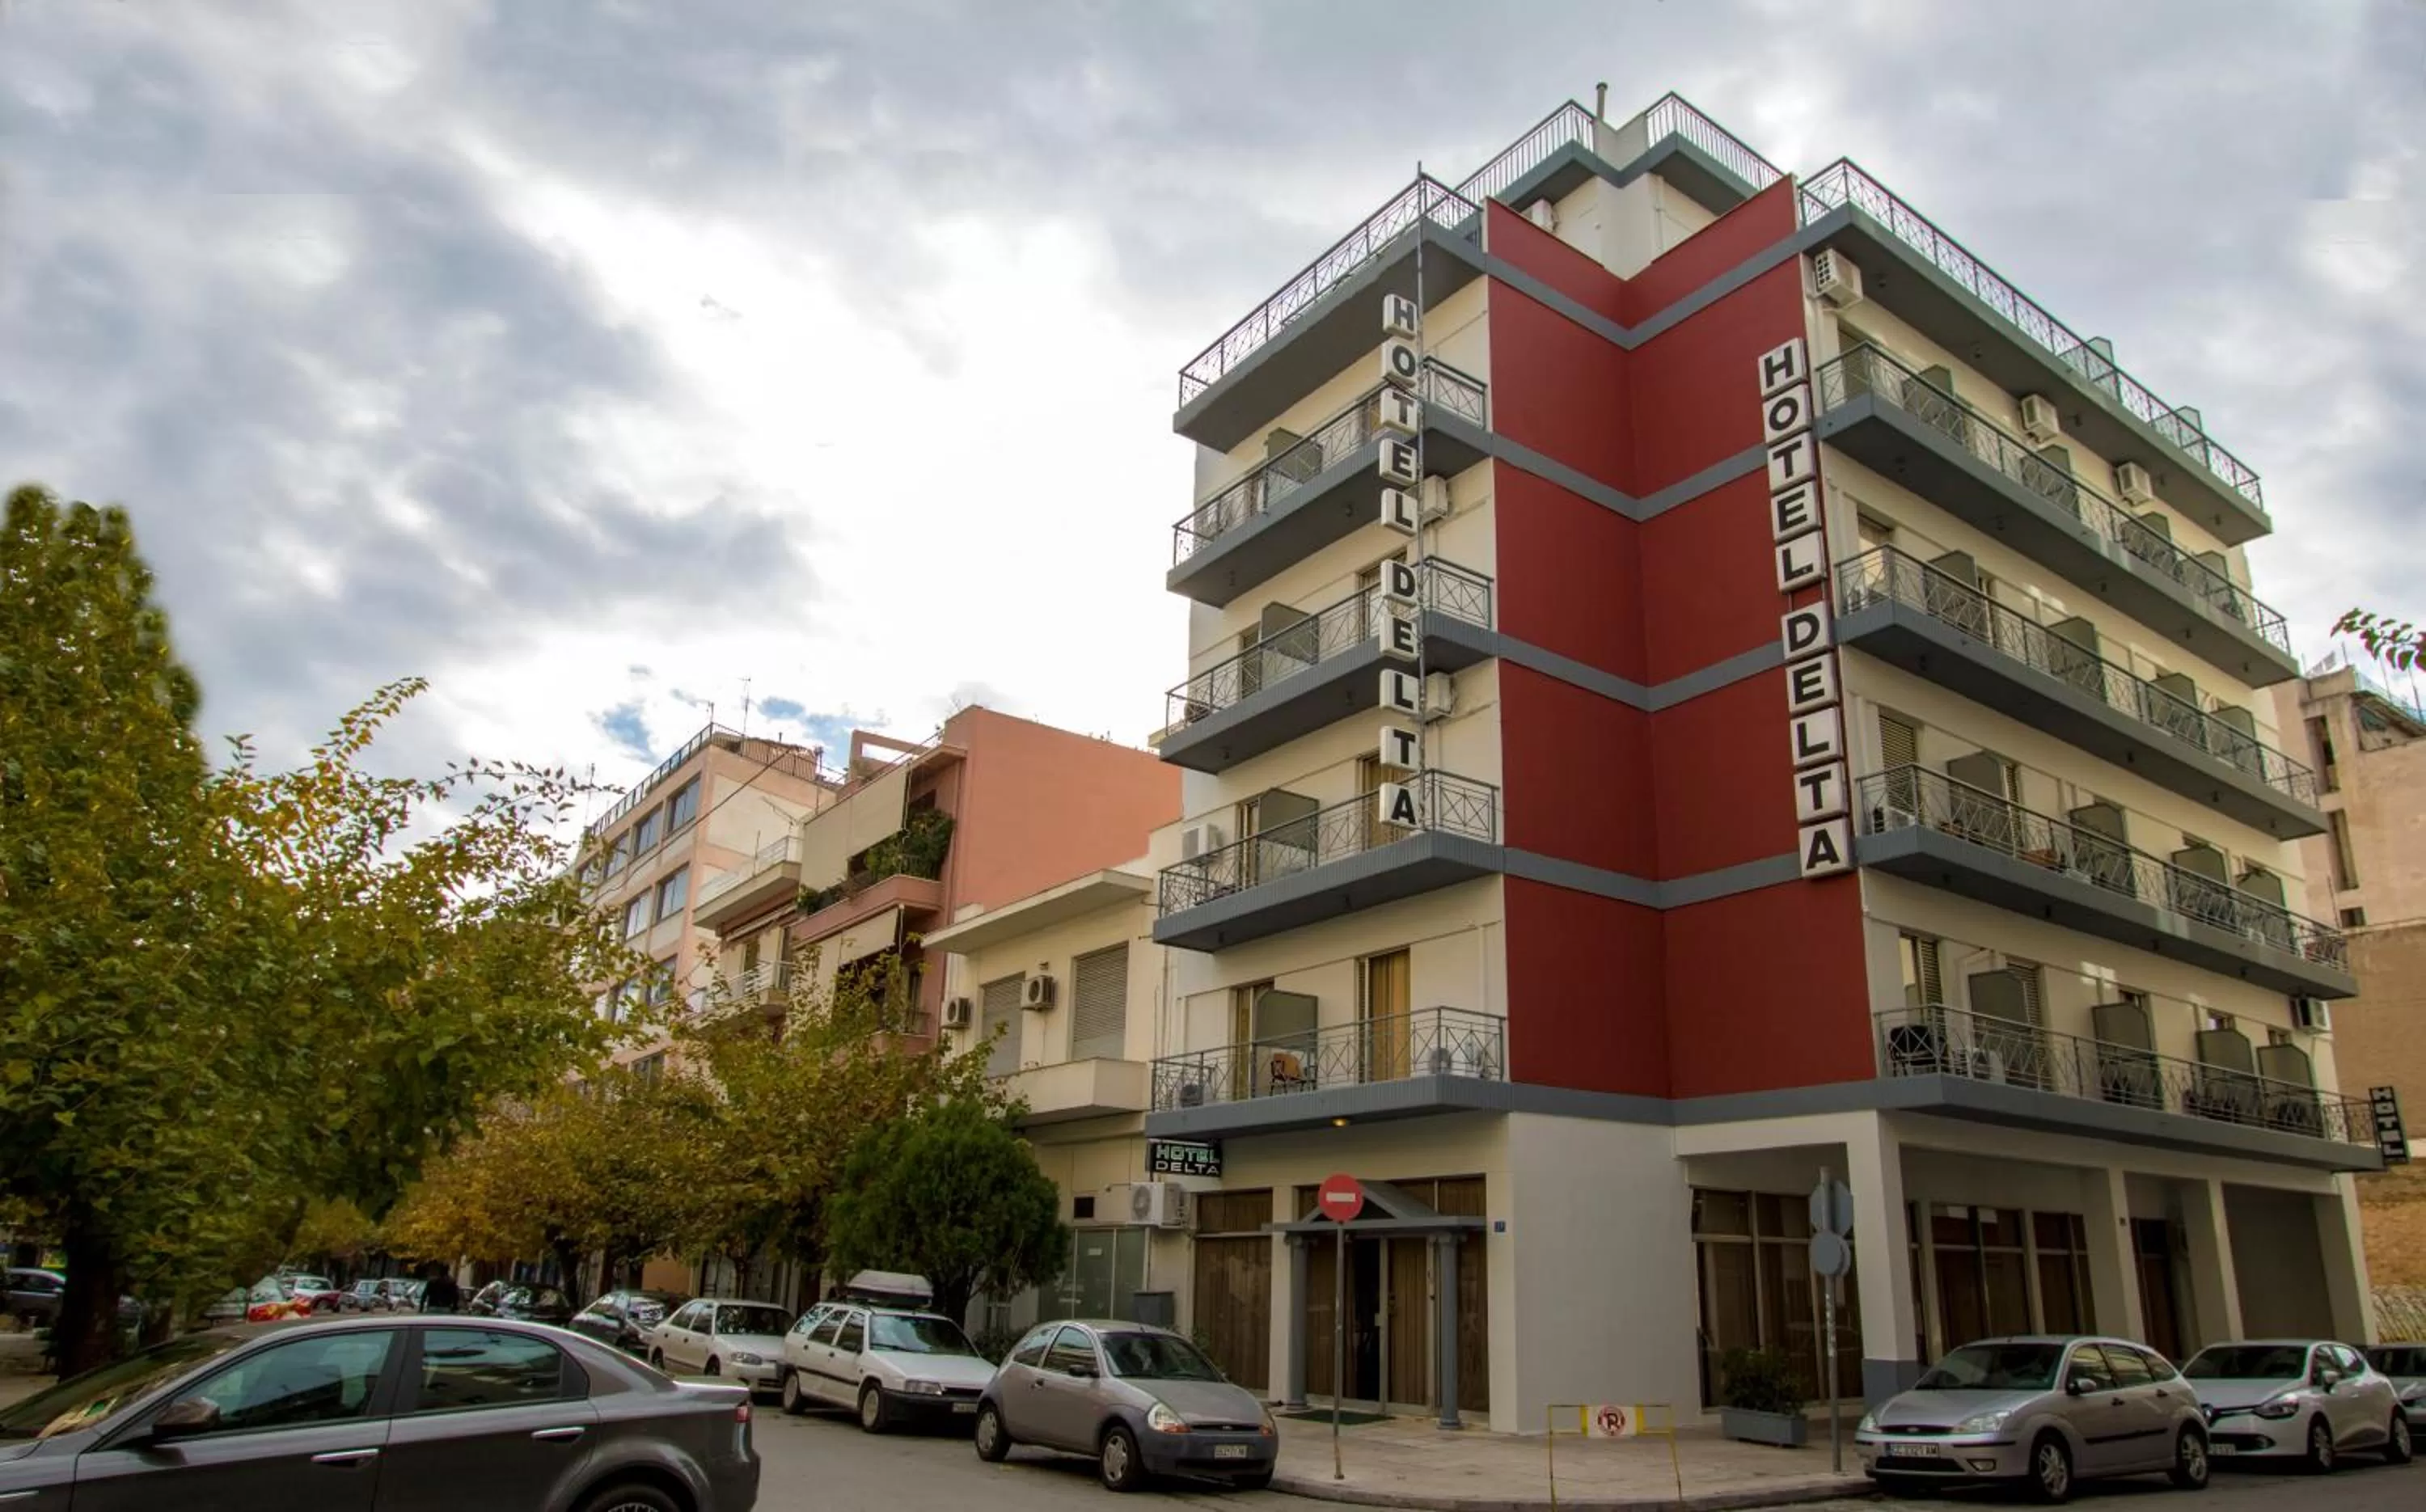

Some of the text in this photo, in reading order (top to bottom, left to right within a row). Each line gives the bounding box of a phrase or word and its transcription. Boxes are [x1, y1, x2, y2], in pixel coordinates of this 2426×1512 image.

[1391, 296, 1417, 825] HOTEL DELTA
[1763, 345, 1839, 871] HOTEL DELTA
[1155, 1160, 1219, 1174] DELTA
[1156, 1144, 1220, 1164] HOTEL
